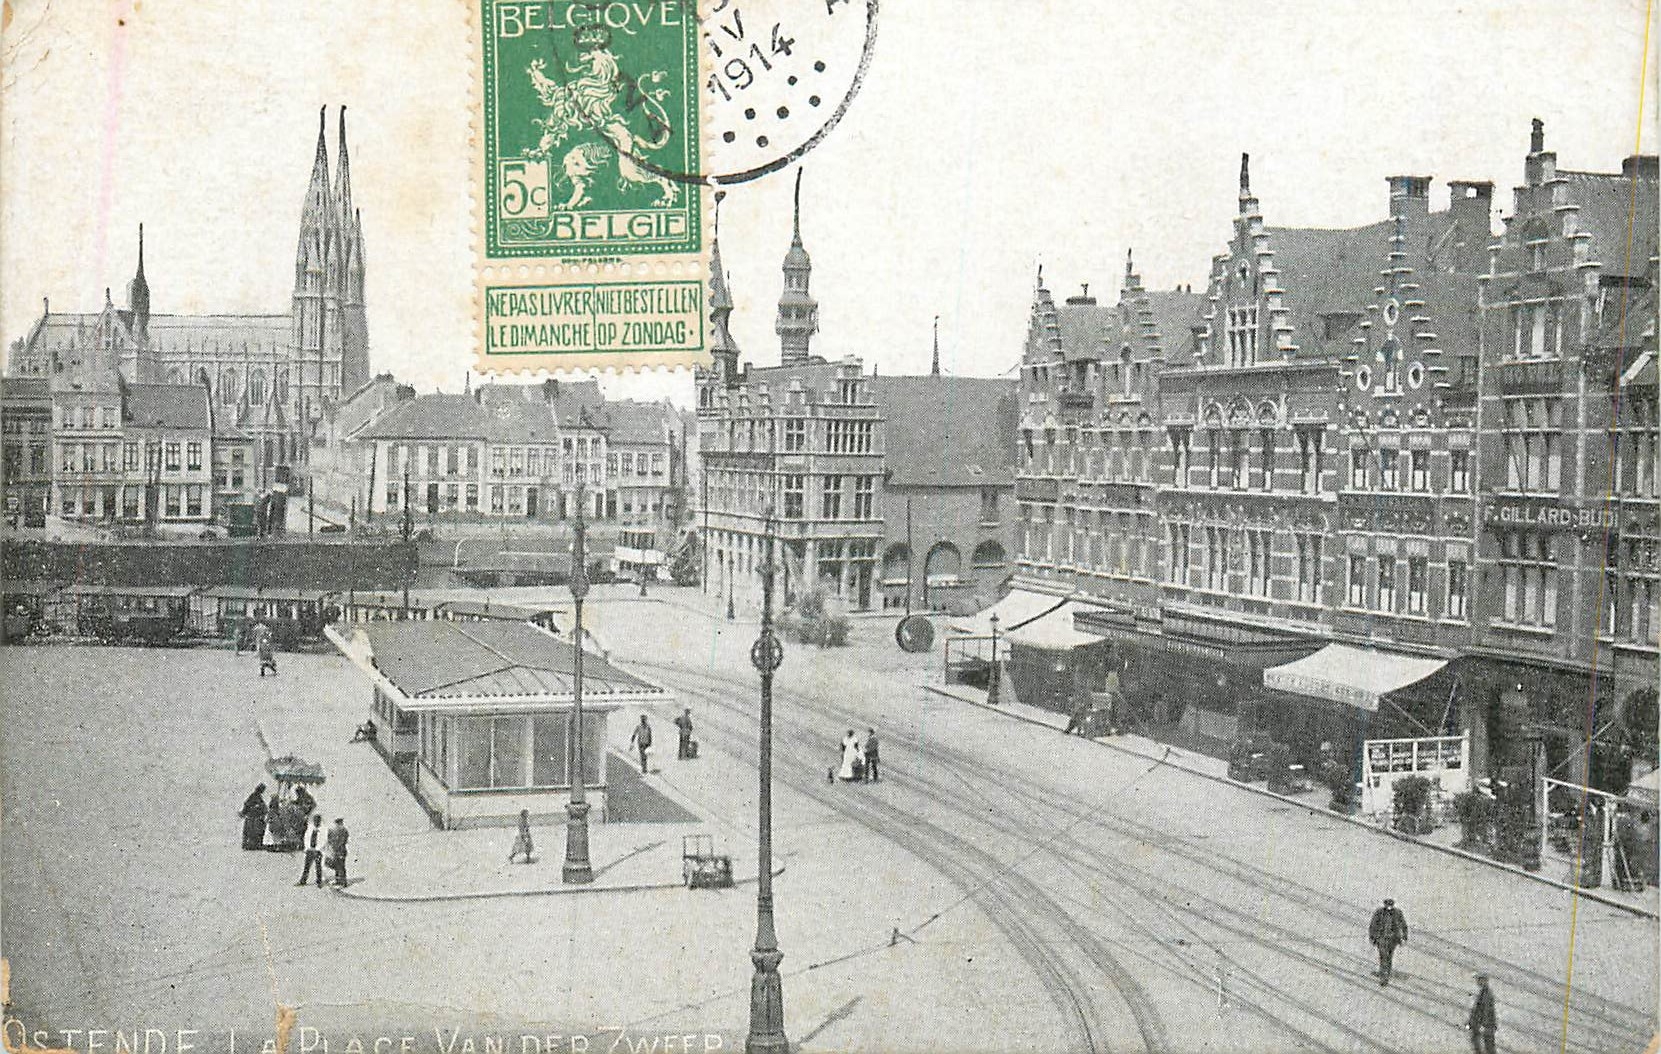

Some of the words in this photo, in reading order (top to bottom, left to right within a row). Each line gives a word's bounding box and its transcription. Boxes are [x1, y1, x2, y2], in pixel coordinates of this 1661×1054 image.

[706, 22, 796, 102] 1914
[553, 213, 686, 241] BELGIE
[489, 293, 508, 317] NE
[509, 293, 538, 317] PAS
[540, 291, 595, 316] LIVRER
[596, 289, 623, 315] NIET
[623, 288, 699, 315] BESTELLEN
[489, 324, 510, 348] LE
[510, 322, 591, 348] DIMANCHE
[598, 322, 617, 346] OP
